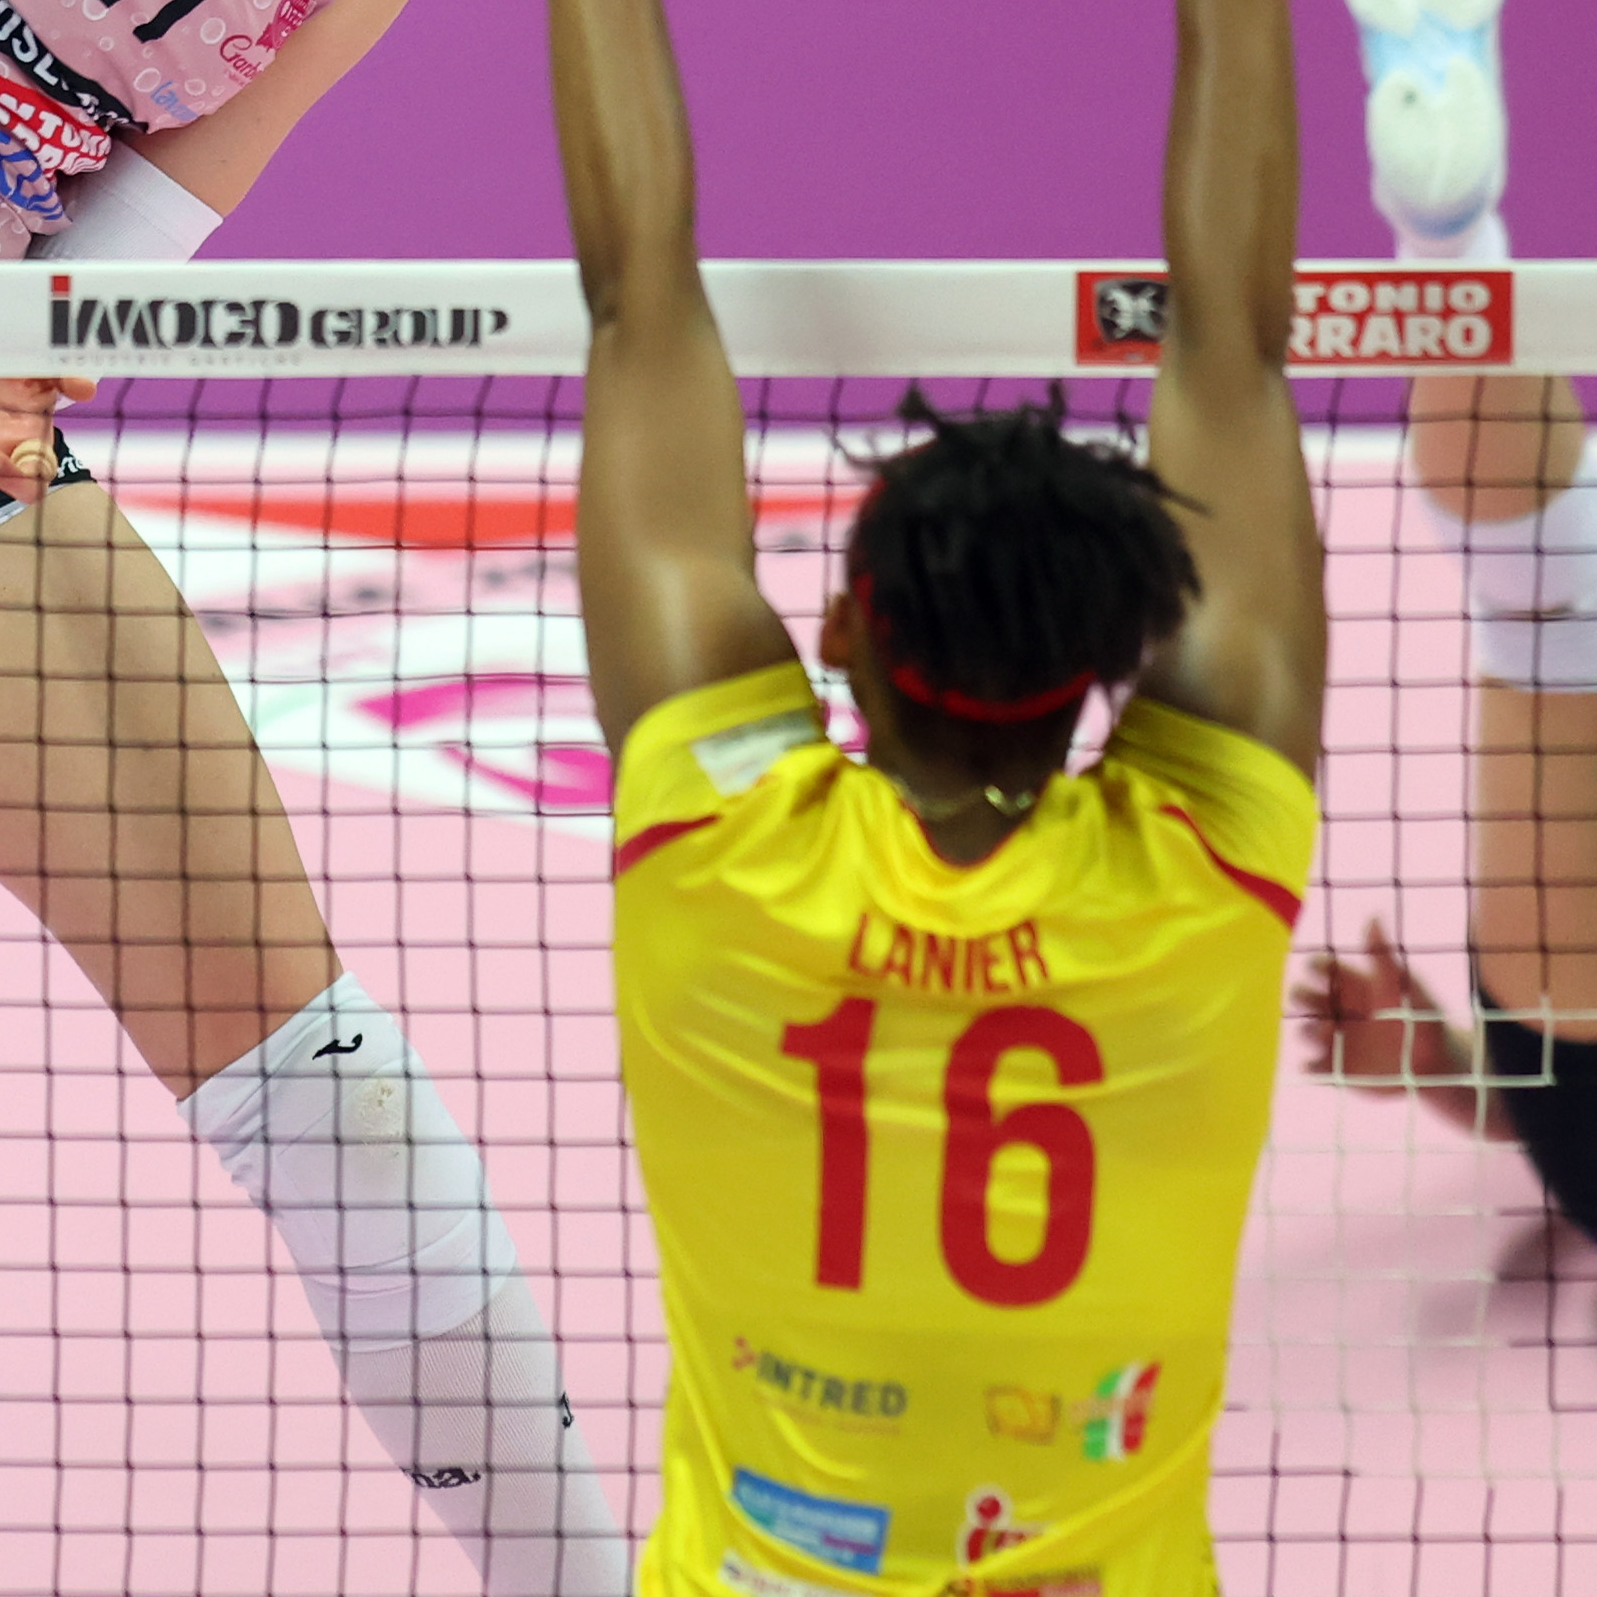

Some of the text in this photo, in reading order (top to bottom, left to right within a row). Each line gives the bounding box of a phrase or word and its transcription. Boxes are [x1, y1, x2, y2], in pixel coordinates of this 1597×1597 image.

[309, 308, 510, 349] GROUP
[1292, 281, 1490, 313] TONIO
[847, 912, 1052, 994] LANIER
[779, 996, 1105, 1310] 16
[757, 1351, 908, 1418] INTRED
